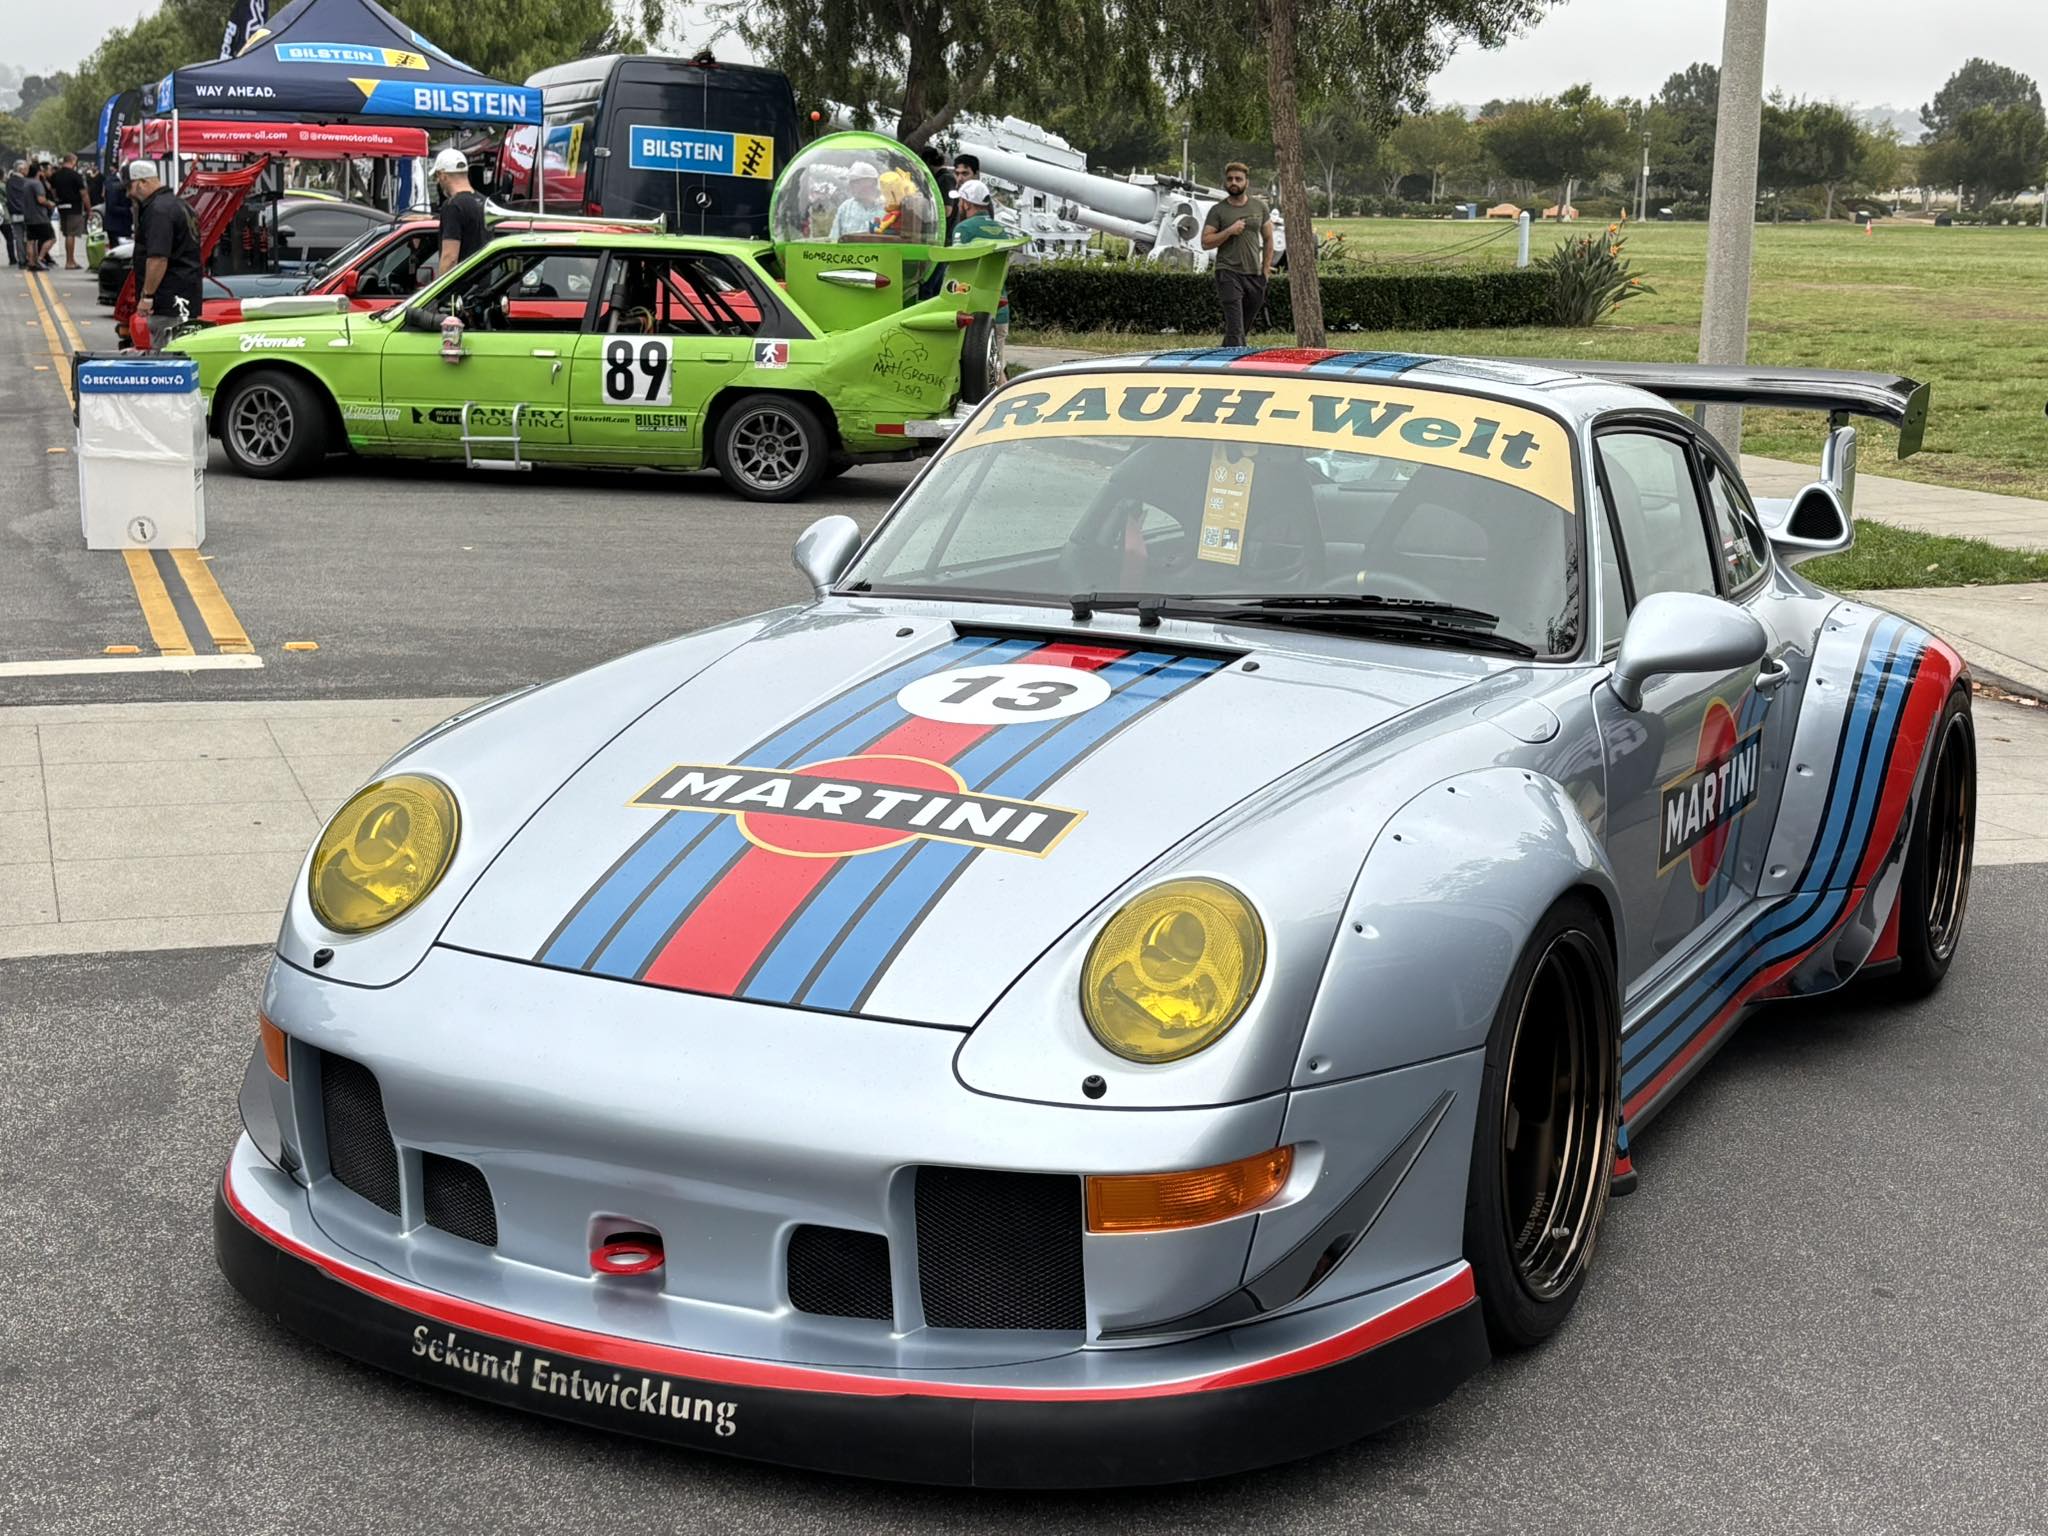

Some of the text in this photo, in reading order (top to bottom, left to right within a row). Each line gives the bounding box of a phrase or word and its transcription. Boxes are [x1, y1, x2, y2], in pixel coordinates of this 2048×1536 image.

[289, 48, 374, 62] BILSTEIN
[196, 85, 276, 98] WAY AHEAD.
[414, 88, 527, 118] BILSTEIN
[202, 130, 288, 141] www.rowe-oil.com
[642, 138, 724, 163] BILSTEIN
[802, 250, 879, 265] HOMERCAR.COM
[93, 375, 174, 385] RECYCLABLES ONLY
[606, 340, 668, 401] 89
[471, 408, 564, 418] ANGRY
[471, 417, 564, 429] HOSTING
[635, 414, 687, 426] BILSTEIN
[976, 386, 1541, 471] RAUH-Welt
[937, 674, 1079, 712] 13
[660, 770, 1049, 844] MARTINI
[1665, 743, 1758, 854] MARTINI
[411, 1325, 739, 1438] Sekund Entwicklung
